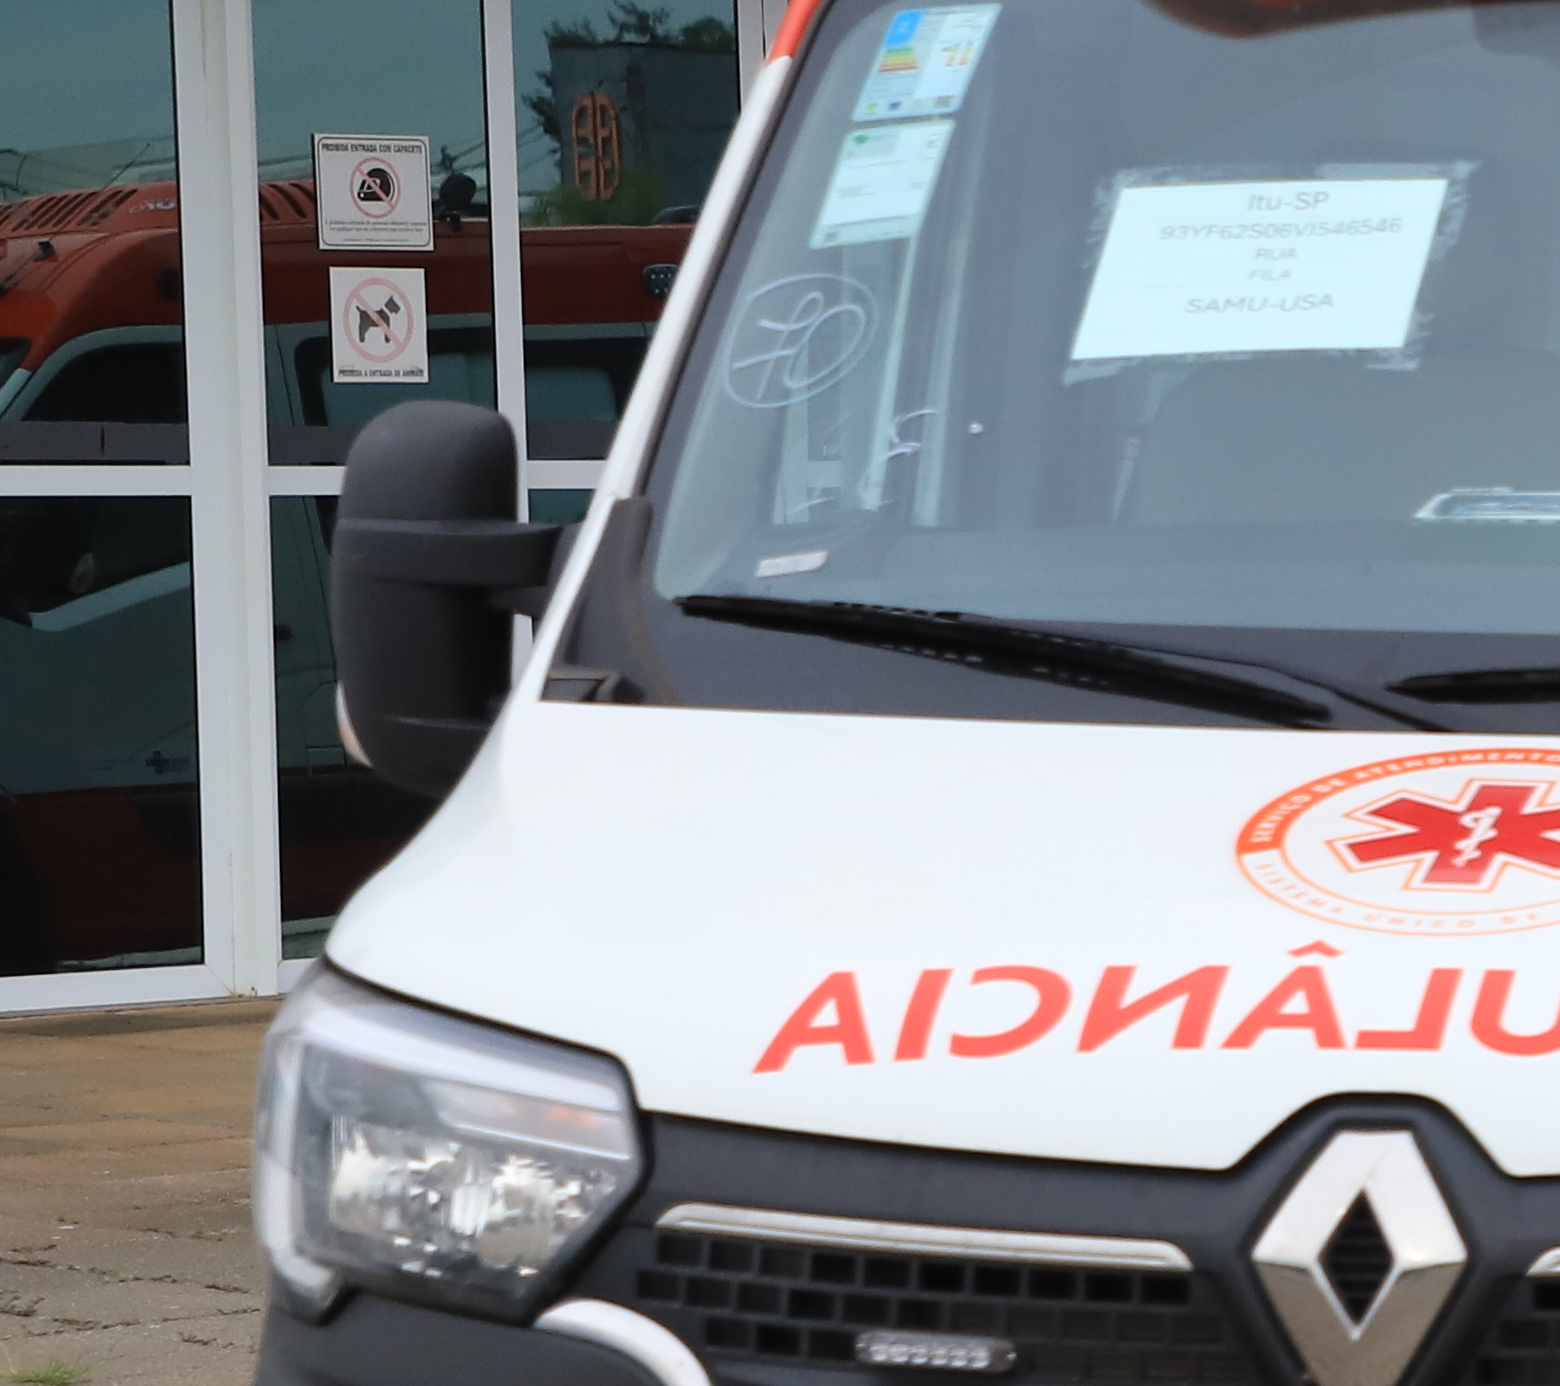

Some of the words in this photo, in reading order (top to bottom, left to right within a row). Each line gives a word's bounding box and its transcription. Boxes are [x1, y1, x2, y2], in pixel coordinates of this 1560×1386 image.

[350, 144, 377, 153] ENTRADA
[1246, 191, 1330, 211] Itu-SP
[1254, 247, 1297, 262] RUA
[1248, 268, 1292, 283] FILA
[1185, 294, 1334, 314] SAMU-USA
[1251, 791, 1311, 844] SERVIÇO
[1311, 777, 1346, 795] DE
[1254, 861, 1344, 914] SISTEMA
[1364, 911, 1477, 929] ÚNICO
[1501, 912, 1540, 926] DE
